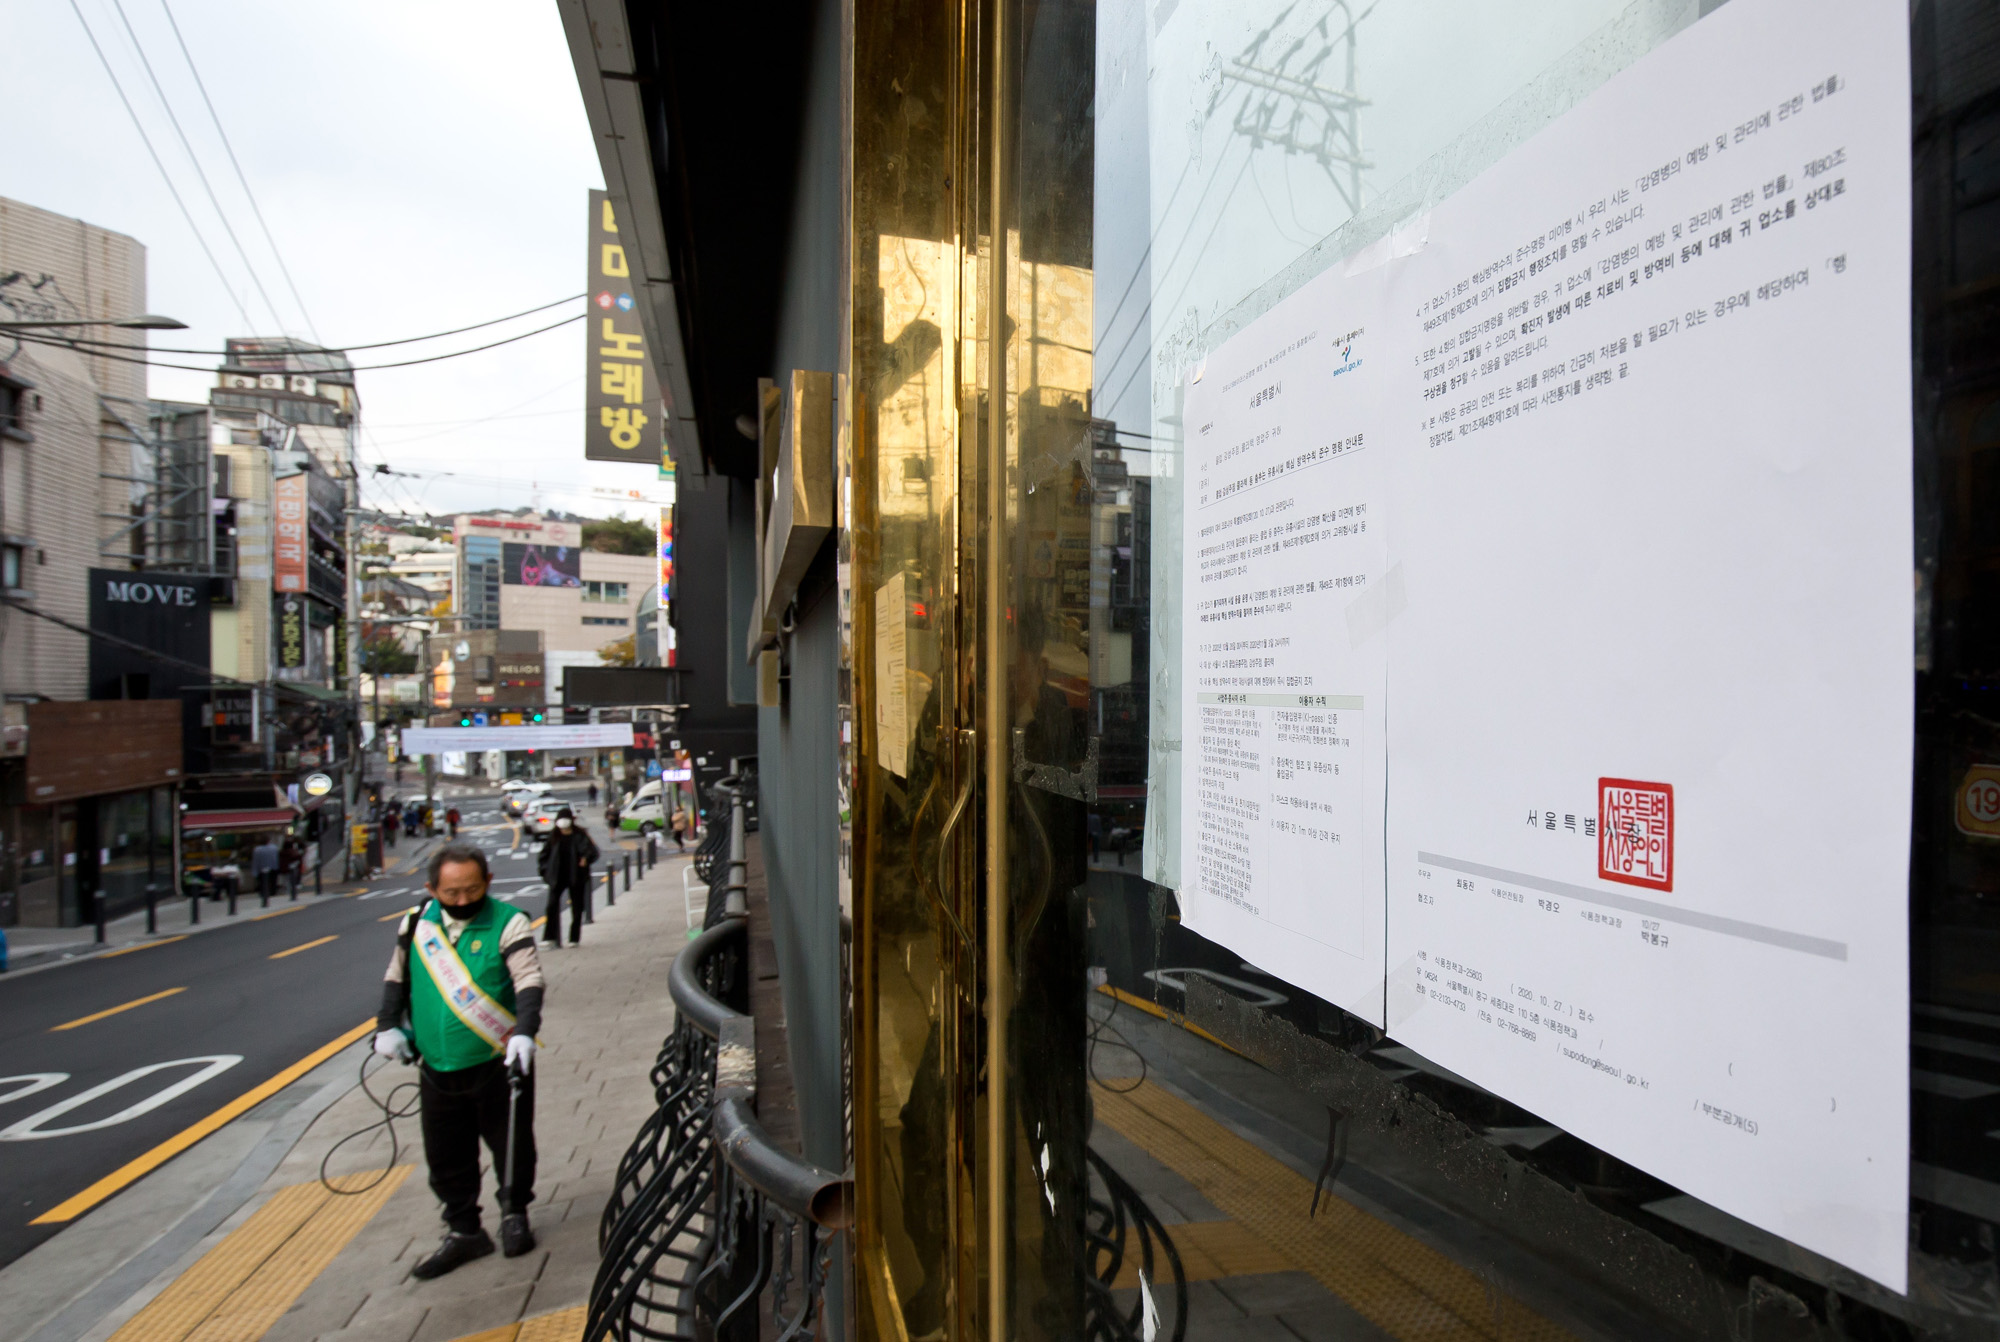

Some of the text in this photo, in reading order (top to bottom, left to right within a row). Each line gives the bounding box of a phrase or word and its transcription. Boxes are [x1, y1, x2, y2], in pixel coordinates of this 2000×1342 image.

[1423, 300, 1429, 314] 귀
[1431, 289, 1450, 310] 업소가
[1515, 233, 1545, 263] 준수명령
[1548, 217, 1572, 241] 미이행
[1575, 210, 1584, 225] 시
[1587, 197, 1606, 219] 우리
[1610, 188, 1630, 206] 시는
[1685, 142, 1710, 165] 예방
[1715, 132, 1727, 153] 및
[1733, 109, 1771, 144] 관리에
[1776, 93, 1804, 122] 관한
[1422, 346, 1436, 362] 또한
[1458, 311, 1504, 346] 집합금지명령을
[1506, 298, 1529, 321] 위반할
[1553, 281, 1562, 297] 귀
[1566, 266, 1592, 292] 업소에
[1644, 230, 1666, 252] 예방
[1671, 222, 1682, 242] 및
[1687, 203, 1723, 234] 관리에
[1729, 189, 1755, 215] 관한
[1423, 361, 1445, 381] 제7호에
[1447, 354, 1459, 370] 의거
[1462, 343, 1481, 363] 고발될
[1484, 340, 1492, 352] 수
[1520, 314, 1543, 335] 확진자
[1546, 300, 1570, 324] 발생에
[1574, 290, 1592, 309] 따른
[1596, 275, 1623, 299] 치료비
[1629, 268, 1638, 287] 및
[1643, 252, 1674, 280] 방역비
[1680, 239, 1702, 264] 등에
[1708, 226, 1732, 249] 대해
[1738, 218, 1751, 238] 귀
[1757, 198, 1796, 230] 업소를
[1803, 177, 1846, 210] 상대로
[1480, 284, 1494, 302] 의거
[1497, 266, 1525, 294] 집합금지
[1528, 243, 1567, 277] 행정조치를
[1571, 232, 1588, 253] 명할
[1591, 226, 1601, 242] 수
[1428, 415, 1436, 429] 본
[1437, 407, 1457, 424] 사항은
[1458, 397, 1478, 417] 공공의
[1480, 390, 1495, 408] 안전
[1497, 385, 1513, 401] 또는
[1515, 373, 1538, 393] 복리를
[1541, 361, 1565, 383] 위하여
[1569, 349, 1595, 373] 긴급히
[1599, 336, 1628, 359] 처분을
[1632, 330, 1643, 348] 할
[1647, 316, 1679, 343] 필요가
[1684, 308, 1708, 329] 있는
[1713, 289, 1750, 318] 경우에
[1756, 267, 1809, 301] 해당하여
[1332, 358, 1363, 377] seoul.go.kr
[1422, 380, 1447, 402] 구상권을
[1449, 370, 1468, 390] 청구할
[1470, 367, 1478, 380] 수
[1480, 356, 1501, 377] 있음을
[600, 318, 648, 450] 노래방
[1249, 380, 1281, 409] 서울특별시
[1522, 395, 1538, 412] 따라
[1540, 379, 1582, 405] 사전통지를
[1318, 446, 1330, 459] 준수
[1331, 441, 1343, 454] 명령
[1344, 434, 1364, 451] 안내문
[1355, 502, 1366, 516] 방지
[106, 580, 197, 607] MOVE
[1354, 573, 1366, 585] 의거
[1298, 695, 1326, 707] 이용자 수칙
[1327, 713, 1338, 725] 인증
[1970, 786, 2000, 815] 19
[1275, 820, 1290, 832] 이용자
[1307, 827, 1317, 839] 이상
[1318, 829, 1328, 842] 간격
[1455, 877, 1475, 892] 최동진
[1537, 898, 1560, 914] 박경오
[1580, 910, 1622, 928] 식품정책과장
[1640, 930, 1669, 948] 박봉규
[1445, 978, 1473, 998] 서울특별시
[1475, 989, 1488, 1003] 중구
[1489, 996, 1514, 1014] 세종대로
[1517, 1006, 1528, 1019] 110
[1528, 1011, 1540, 1025] 5층
[1542, 1017, 1578, 1040] 식품정책과
[1577, 1007, 1594, 1024] 접수
[1496, 1016, 1536, 1042] 02-768-8869
[1562, 1046, 1650, 1090] supodong@seoul.go.kr
[1701, 1101, 1759, 1136] 부분공개(5)
